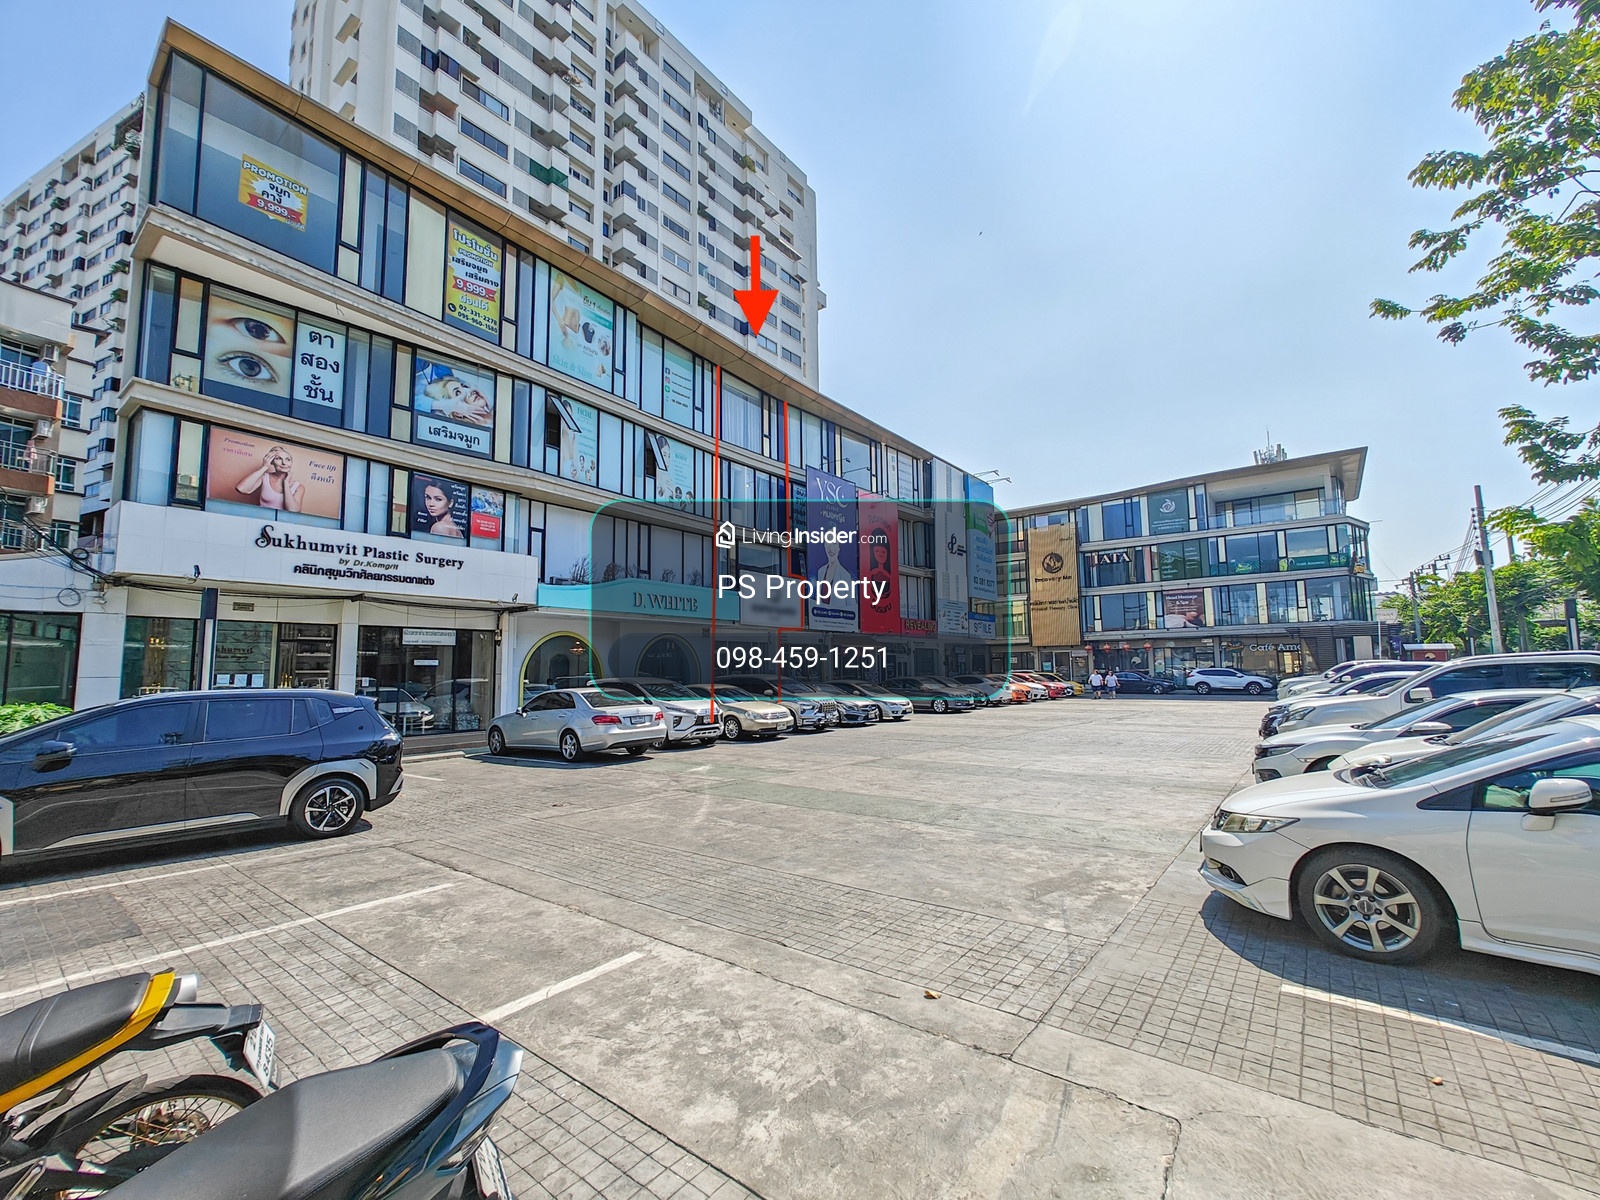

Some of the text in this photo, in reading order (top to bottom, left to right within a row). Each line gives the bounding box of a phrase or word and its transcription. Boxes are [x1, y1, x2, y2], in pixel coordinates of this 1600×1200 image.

[242, 160, 309, 196] PROMOTION
[261, 190, 282, 204] คาง
[268, 182, 291, 199] จมูก
[256, 198, 297, 219] 9,999.-
[453, 228, 498, 261] โปรโมชั่น
[451, 255, 488, 275] เสริมจมูก
[458, 247, 494, 267] PROMOTION
[456, 278, 495, 298] 9,999.-
[464, 271, 499, 288] เสริมคาง
[459, 293, 489, 311] ผ่อนได้
[458, 304, 498, 326] 02-331-2278
[308, 330, 334, 349] ตา
[300, 352, 340, 373] สอง
[303, 374, 334, 404] ชั้น
[224, 437, 255, 449] Promotion
[428, 424, 480, 449] เสริมจมูก
[308, 460, 338, 473] Face lift
[815, 477, 849, 509] YSC
[255, 524, 464, 570] Sukhumvit Plastic Surgery
[339, 557, 399, 571] by Dr.Komgrit
[293, 563, 436, 587] คลินิกสุขุมวิทศัลยกรรมตกแต่ง
[633, 592, 698, 612] D. WHITE
[1249, 643, 1275, 652] Café
